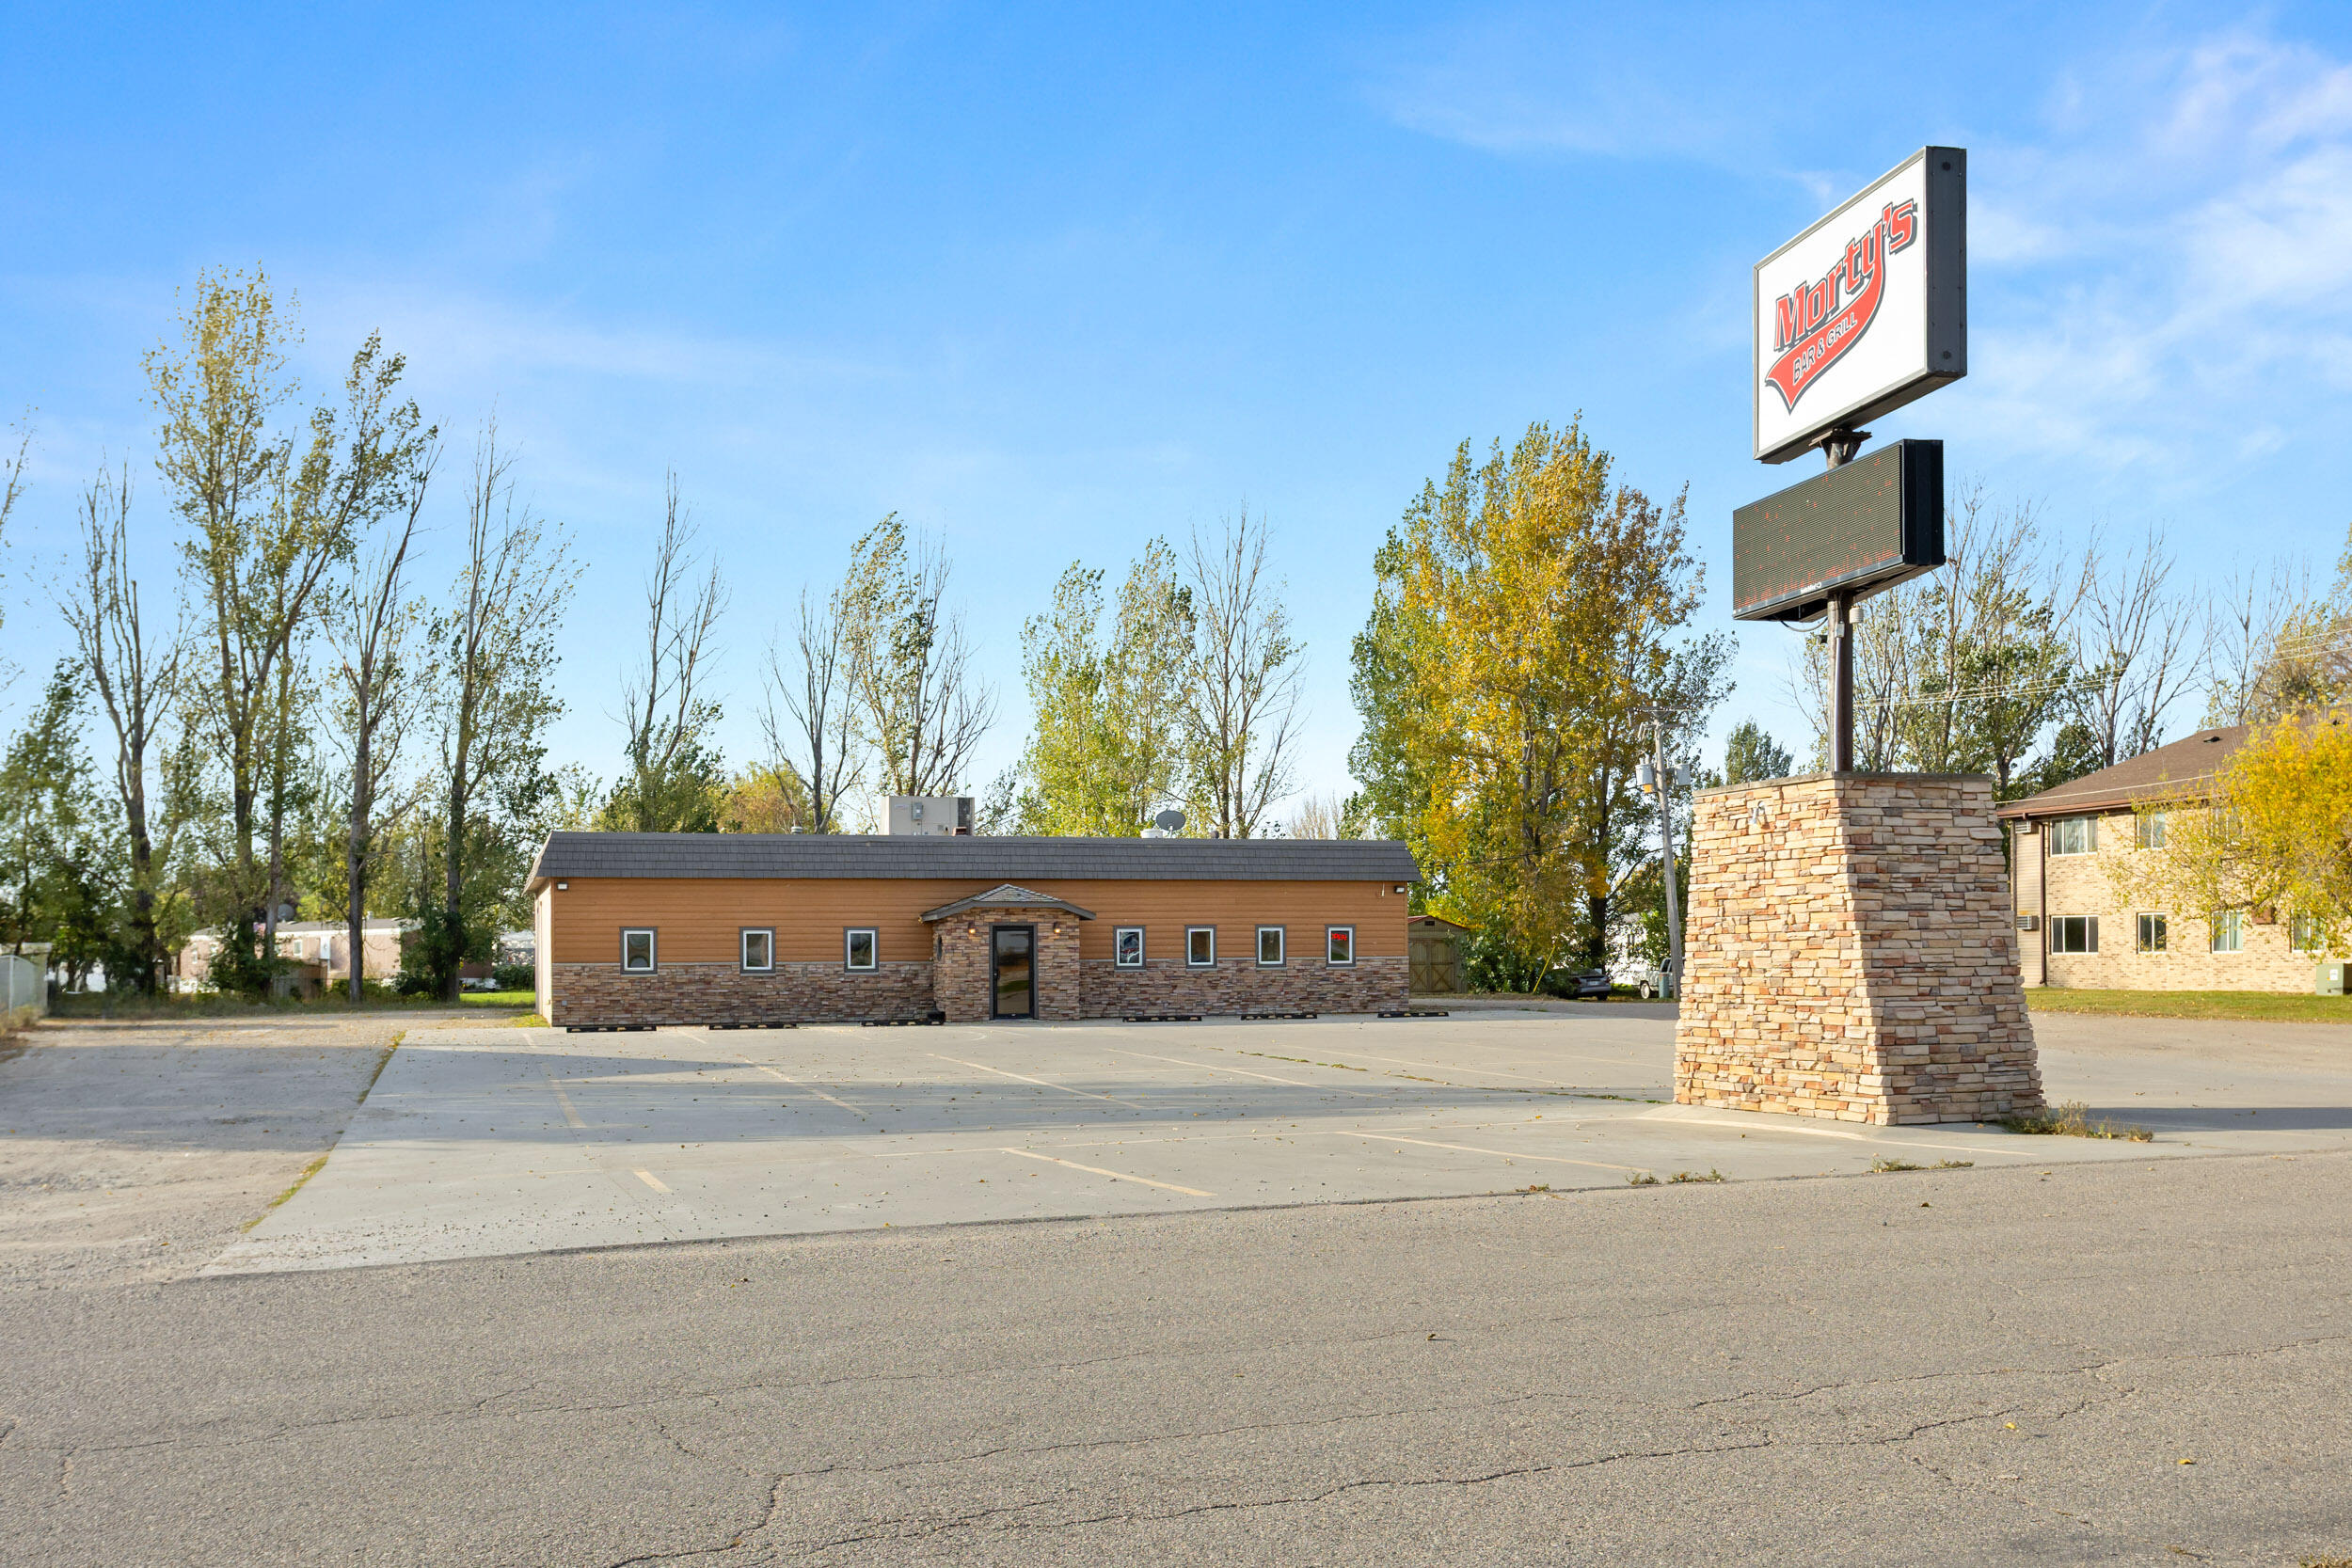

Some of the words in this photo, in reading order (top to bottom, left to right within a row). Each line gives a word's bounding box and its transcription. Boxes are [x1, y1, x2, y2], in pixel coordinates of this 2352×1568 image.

[1773, 198, 1917, 352] Morty's
[1793, 345, 1815, 386] BAR
[1817, 337, 1825, 358] &
[1826, 311, 1858, 348] GRILL
